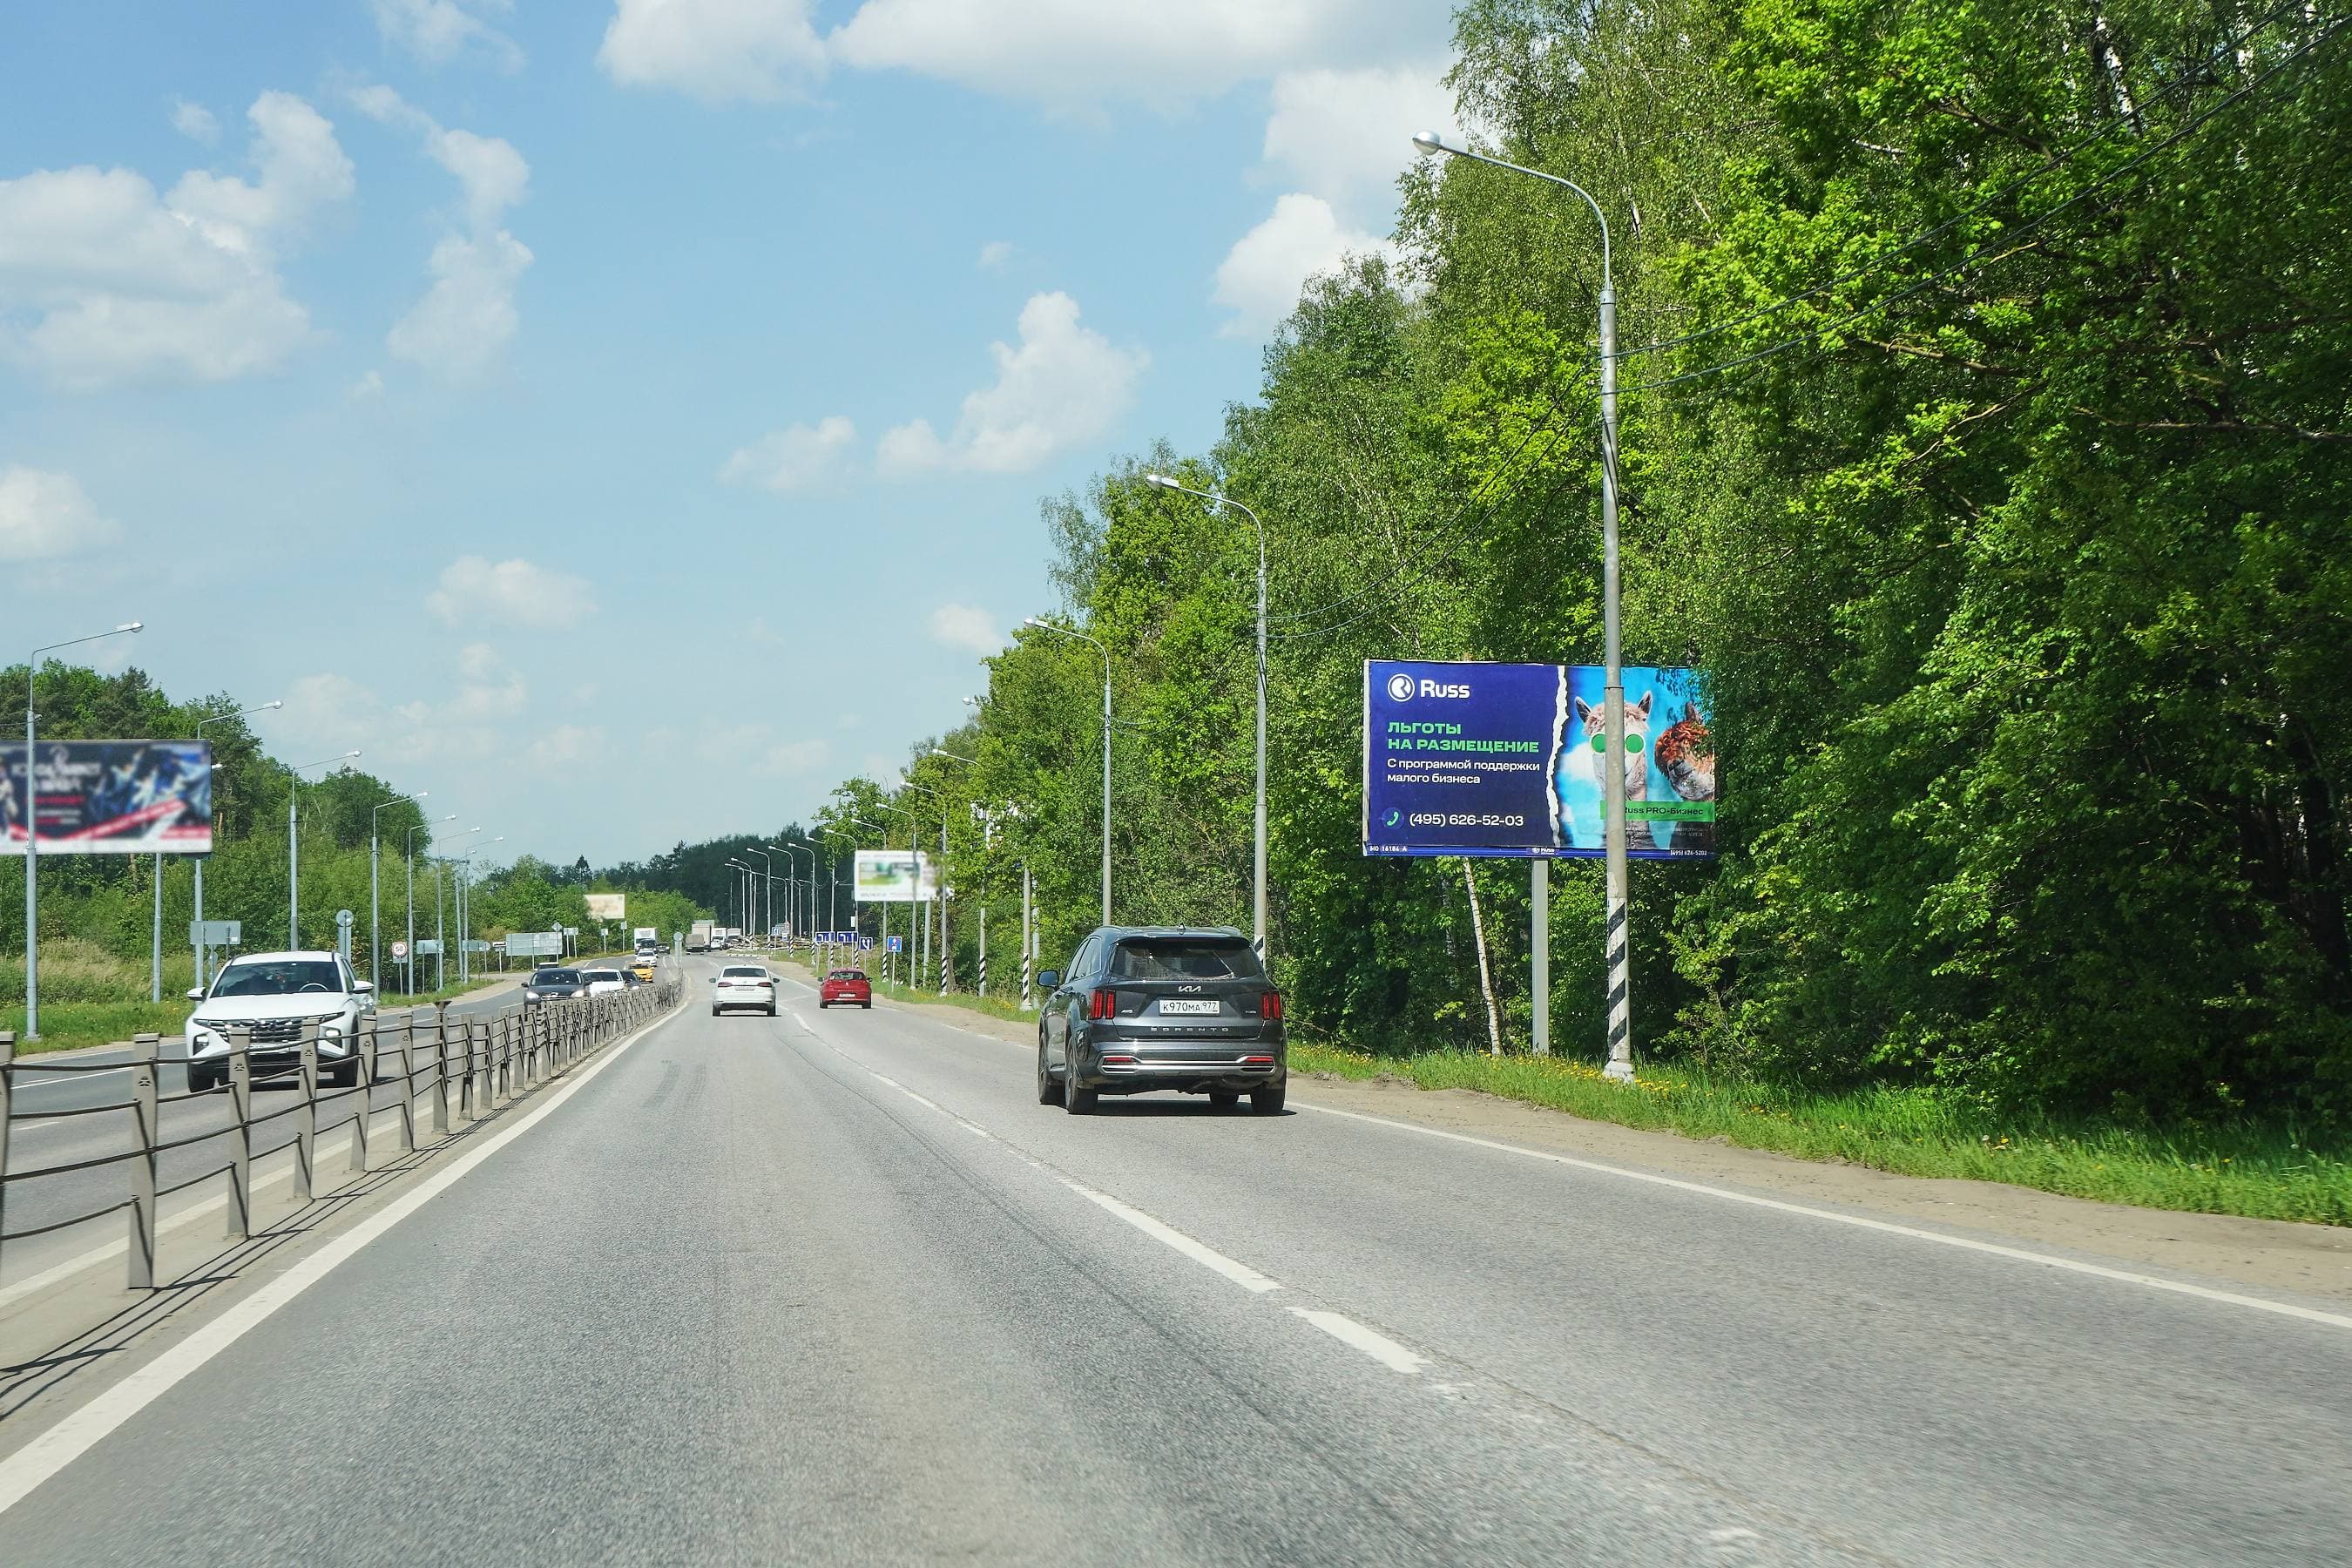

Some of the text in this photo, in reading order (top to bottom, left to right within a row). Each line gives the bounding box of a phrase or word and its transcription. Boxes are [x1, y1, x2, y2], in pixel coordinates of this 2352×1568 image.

[1420, 679, 1470, 699] Russ
[1387, 721, 1462, 735] ЛЬГОТЫ
[1388, 738, 1539, 754] НА РАЗМЕЩЕНИЕ
[1387, 758, 1540, 773] С программой поддержки
[1387, 773, 1481, 784] малого бизнеса
[1646, 807, 1704, 815] PRO-Бизнес
[1409, 813, 1524, 828] (495) 626-52-03
